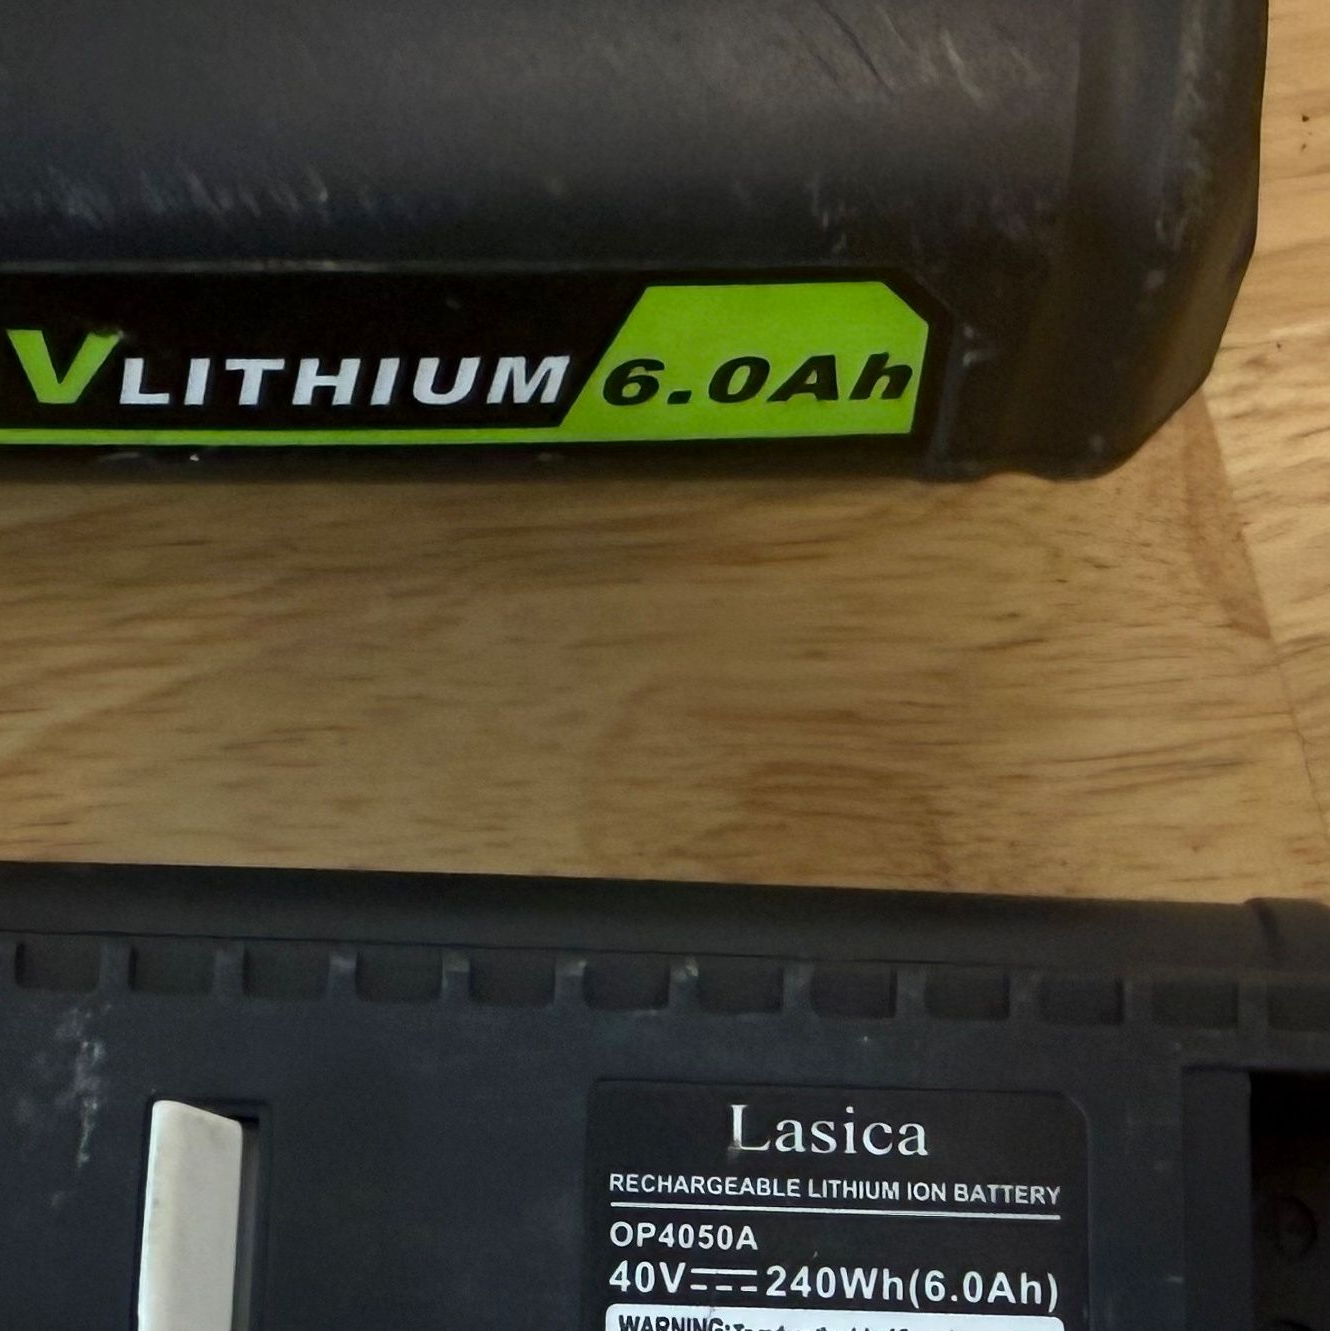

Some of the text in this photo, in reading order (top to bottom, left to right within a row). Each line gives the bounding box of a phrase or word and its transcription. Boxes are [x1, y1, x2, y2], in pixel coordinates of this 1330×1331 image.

[119, 354, 571, 407] LITHIUM
[601, 349, 913, 407] 6.0Ah
[729, 1103, 929, 1157] Lasica
[609, 1173, 1061, 1205] RECHARGEABLE LITHIUM ION BATTERY
[609, 1221, 758, 1250] OP4050A
